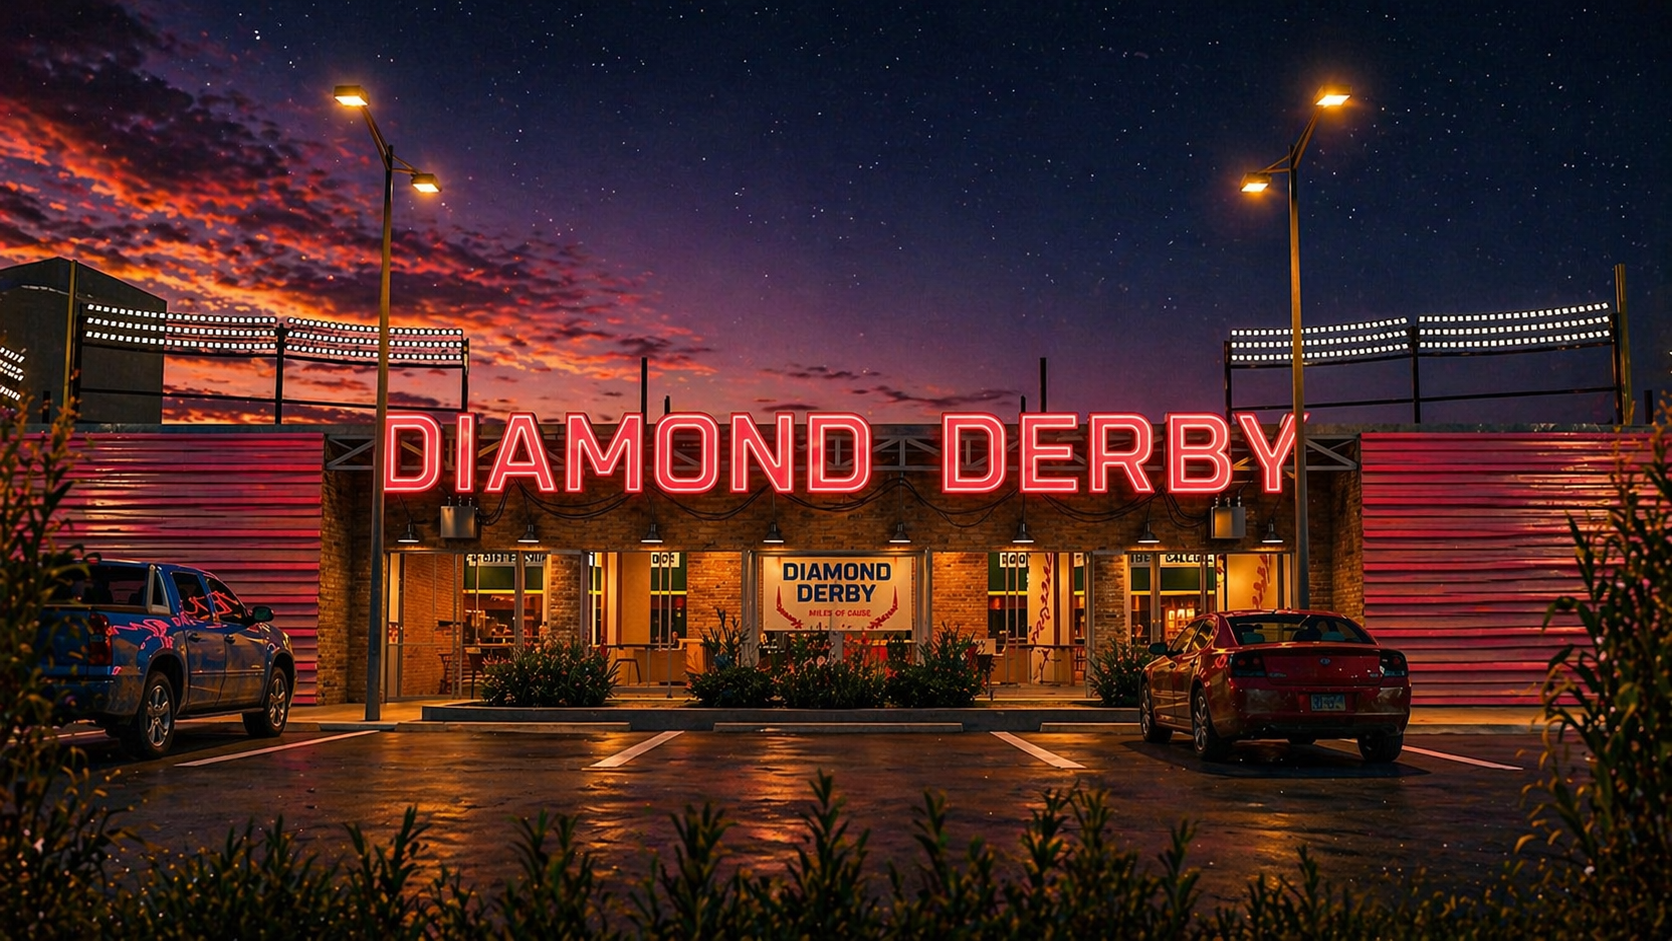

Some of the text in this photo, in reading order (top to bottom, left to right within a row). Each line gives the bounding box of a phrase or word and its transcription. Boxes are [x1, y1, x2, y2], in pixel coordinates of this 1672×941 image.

[384, 412, 1310, 494] DIAMOND DERBY
[783, 563, 891, 581] DIAMOND
[797, 584, 876, 602] DERBY
[809, 609, 871, 617] MILES OF CAUSE
